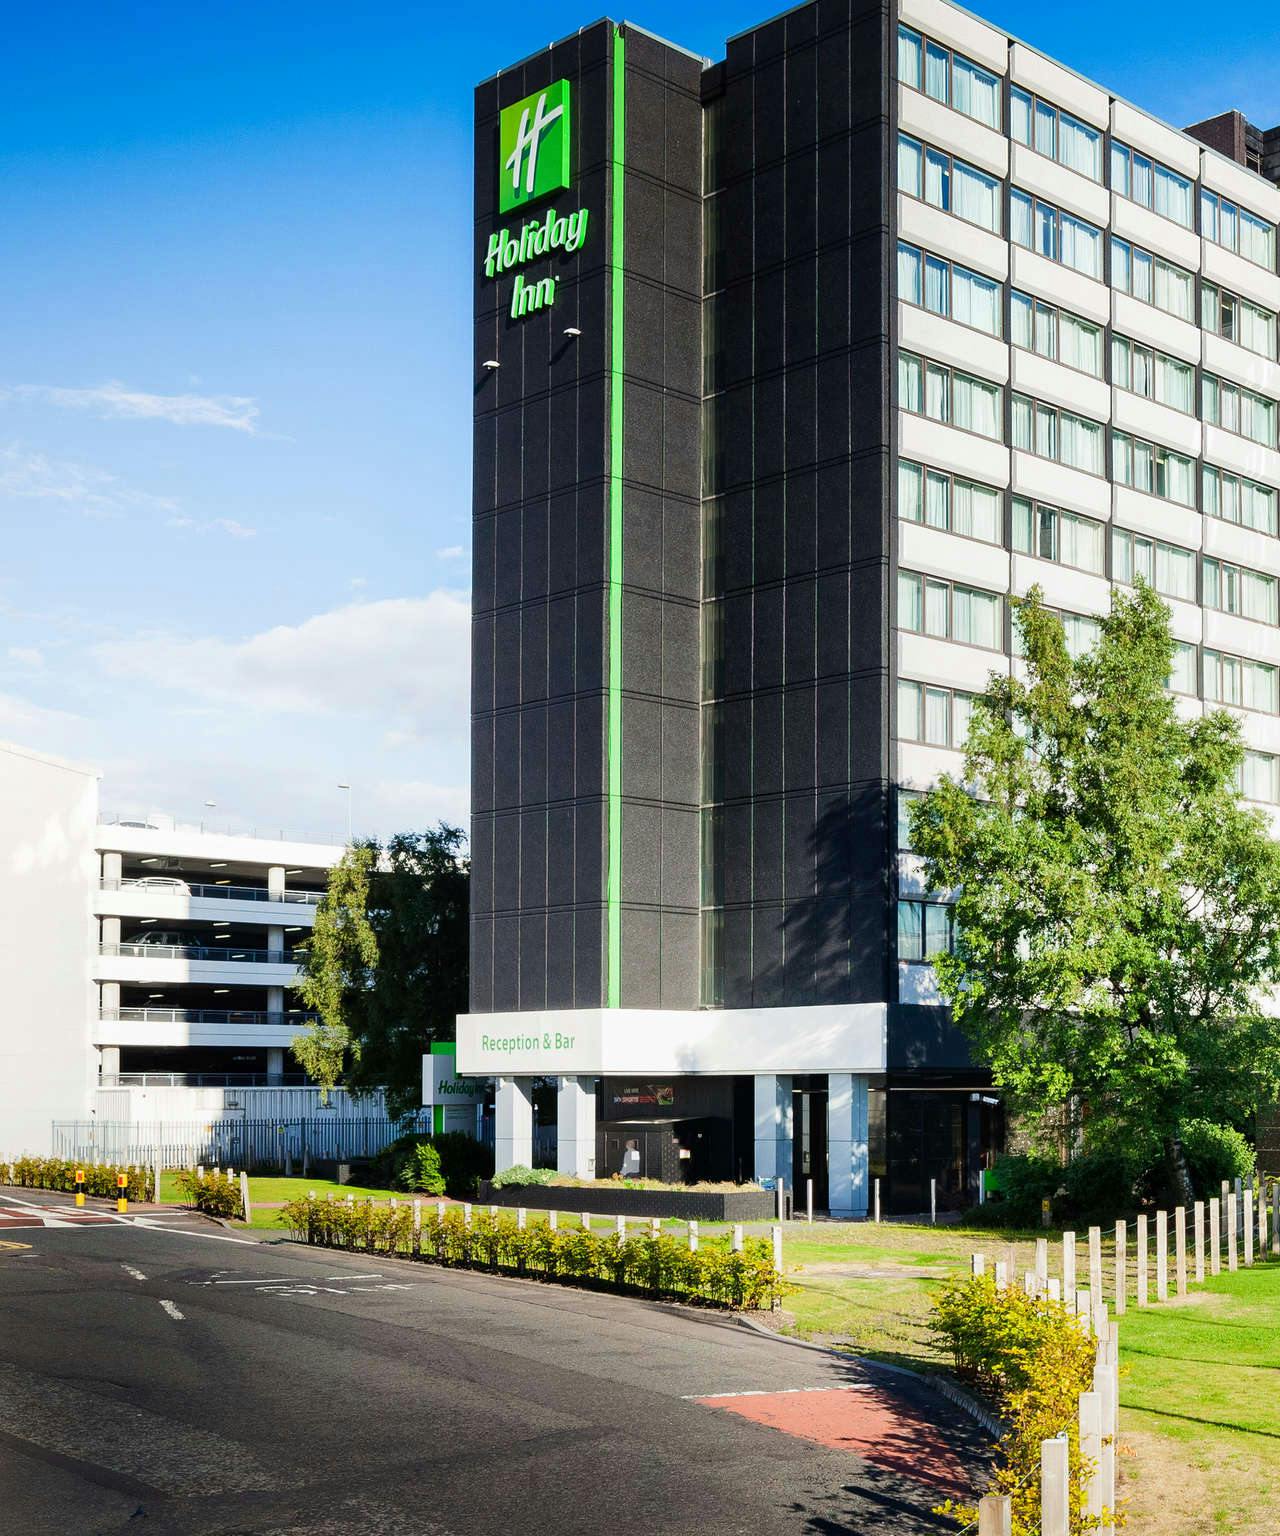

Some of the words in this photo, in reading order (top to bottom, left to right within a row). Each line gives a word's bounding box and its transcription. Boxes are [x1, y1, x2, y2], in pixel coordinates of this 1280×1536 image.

[484, 208, 588, 278] Holiday
[511, 274, 555, 319] Inn
[481, 1033, 540, 1055] Reception
[543, 1032, 552, 1050] &
[555, 1032, 576, 1050] Bar
[438, 1080, 475, 1097] Holiday
